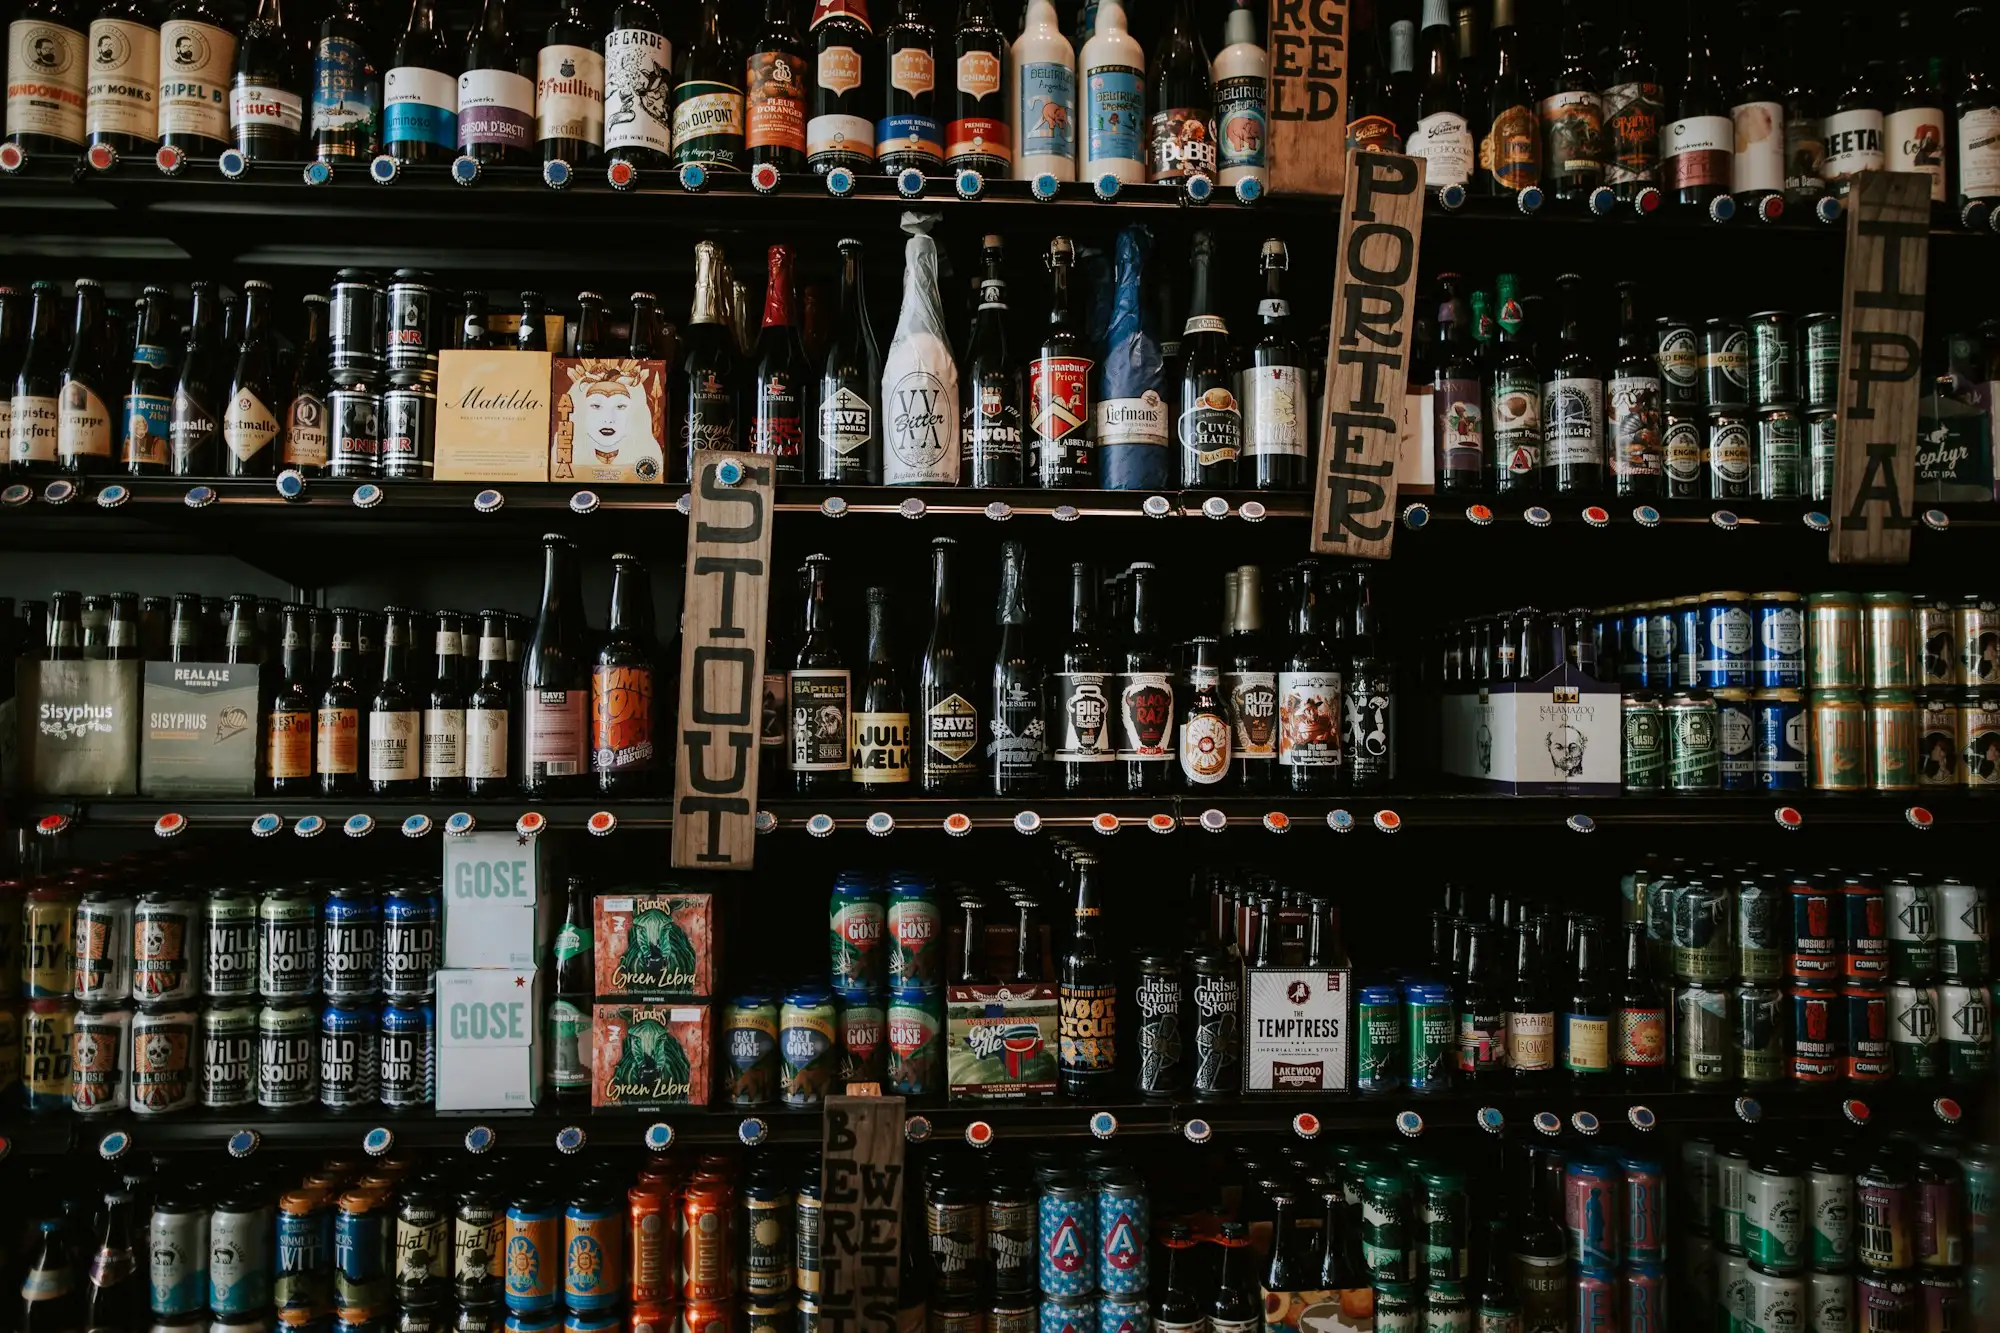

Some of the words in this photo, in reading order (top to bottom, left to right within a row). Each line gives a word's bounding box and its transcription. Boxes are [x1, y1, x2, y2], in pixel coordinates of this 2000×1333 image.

[609, 31, 621, 47] DE
[623, 31, 663, 50] GARDE
[823, 69, 857, 79] CHIMAY
[897, 71, 931, 81] CHIMAY
[962, 74, 997, 83] CHIMAY
[108, 84, 152, 102] MONKS
[160, 83, 206, 100] TRIPEL
[757, 105, 803, 118] D'ORANGER
[767, 99, 795, 107] FLEUR
[692, 110, 733, 127] DUPONT
[890, 119, 913, 127] GRANDE
[1321, 154, 1418, 543] PORTER
[1055, 372, 1078, 381] Prior
[1841, 221, 1927, 528] IPA
[445, 386, 543, 410] Matilda
[822, 410, 867, 426] SAVE
[895, 413, 945, 433] Bitter
[1106, 405, 1158, 424] Liefmans
[1063, 439, 1082, 447] ABBEY
[1921, 470, 1937, 478] OAT
[1941, 470, 1957, 478] IPA
[680, 463, 770, 861] STOUT
[175, 668, 205, 681] REAL
[208, 670, 229, 682] ALE
[794, 685, 846, 693] BAPTIST
[1244, 692, 1274, 706] BUZZ
[40, 704, 113, 722] Sisyphus
[1079, 701, 1102, 715] BIG
[1244, 705, 1274, 718] NUTZ
[1539, 705, 1595, 714] KALAMAZOO
[150, 713, 207, 730] SISYPHUS
[933, 717, 974, 731] SAVE
[1076, 715, 1100, 723] BLACK
[397, 739, 407, 748] ALE
[446, 734, 456, 743] ALE
[1633, 735, 1654, 745] OASIS
[818, 749, 844, 758] SERIES
[454, 859, 527, 900] GOSE
[849, 923, 880, 940] GOSE
[898, 922, 931, 938] GOSE
[326, 928, 374, 952] WiLD
[386, 928, 433, 952] WiLD
[1798, 939, 1827, 948] MOSAIC
[210, 951, 257, 971] SOUR
[327, 953, 374, 971] SOUR
[386, 953, 433, 971] SOUR
[1795, 959, 1836, 970] COMMUNITY
[612, 965, 656, 988] Green
[658, 968, 696, 988] Zebra
[449, 1002, 524, 1040] GOSE
[1258, 1019, 1339, 1038] TEMPTRESS
[733, 1030, 756, 1043] G&T
[789, 1029, 812, 1042] G&T
[847, 1027, 879, 1044] GOSE
[890, 1027, 921, 1045] GOSE
[969, 1025, 1005, 1046] Gose
[204, 1039, 251, 1064] WiLD
[262, 1039, 310, 1063] WiLD
[731, 1042, 759, 1057] GOSE
[786, 1041, 814, 1056] GOSE
[975, 1038, 1003, 1060] Ale
[1796, 1041, 1825, 1051] MOSAIC
[203, 1064, 251, 1082] SOUR
[262, 1064, 309, 1082] SOUR
[1274, 1067, 1321, 1076] LAKEWOOD
[1795, 1063, 1836, 1074] COMMUNITY
[606, 1077, 650, 1099] Green
[653, 1079, 690, 1099] Zebra
[397, 1231, 424, 1258] Hat
[425, 1218, 448, 1250] Tip
[456, 1231, 483, 1255] Hat
[484, 1218, 506, 1250] Tip
[1053, 1226, 1079, 1257] A
[1108, 1224, 1136, 1255] A
[942, 1255, 966, 1273] JAM
[996, 1252, 1020, 1269] JAM
